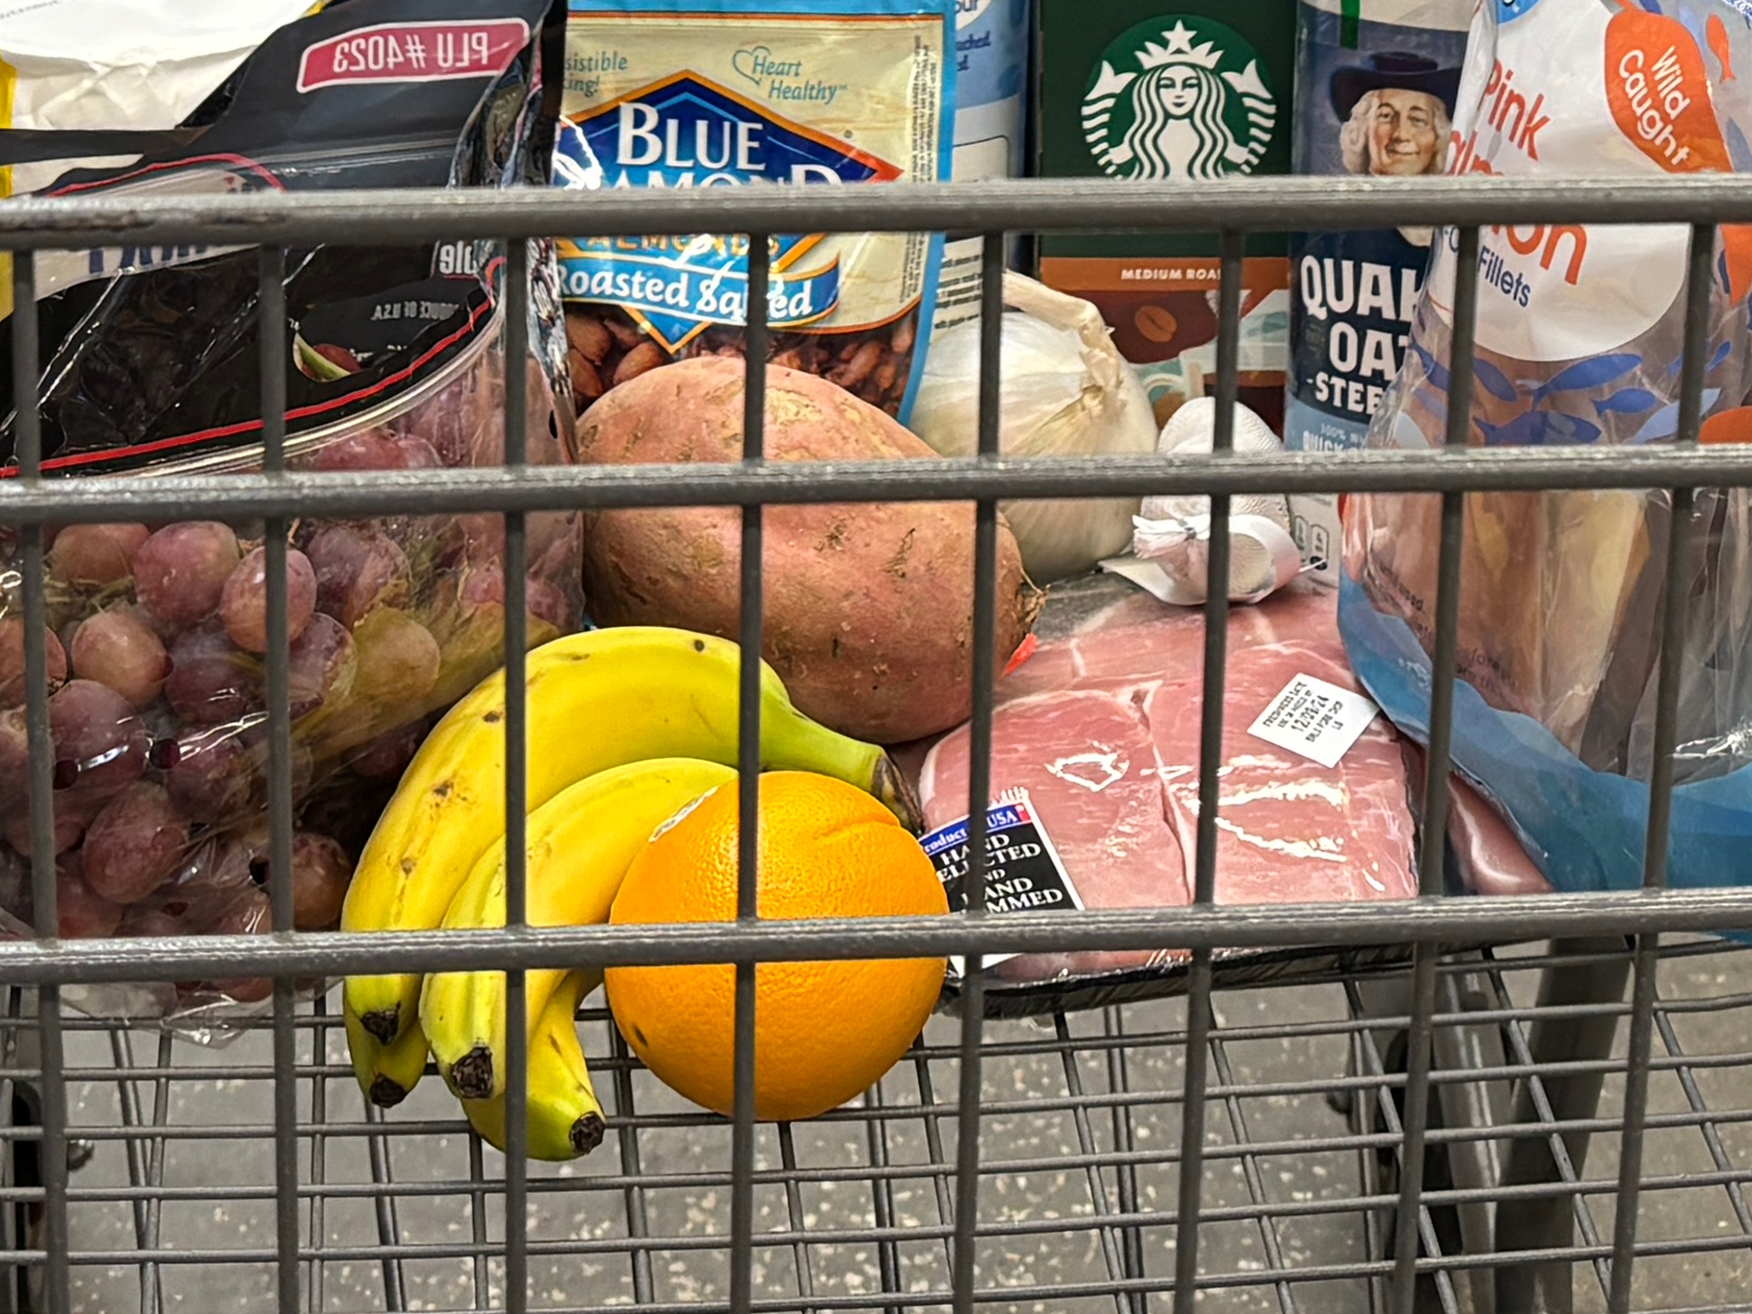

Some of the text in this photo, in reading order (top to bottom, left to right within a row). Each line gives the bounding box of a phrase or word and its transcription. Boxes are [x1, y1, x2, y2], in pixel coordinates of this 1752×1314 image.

[751, 56, 803, 78] Heart
[767, 79, 838, 105] Healthy
[1649, 44, 1691, 117] Wild
[1485, 62, 1552, 161] Pink
[1617, 48, 1691, 164] Caught
[616, 100, 767, 171] BLUE
[557, 266, 690, 308] Roasted
[1120, 268, 1183, 281] MEDIUM
[1477, 243, 1532, 309] Fillets
[986, 810, 1018, 829] USA
